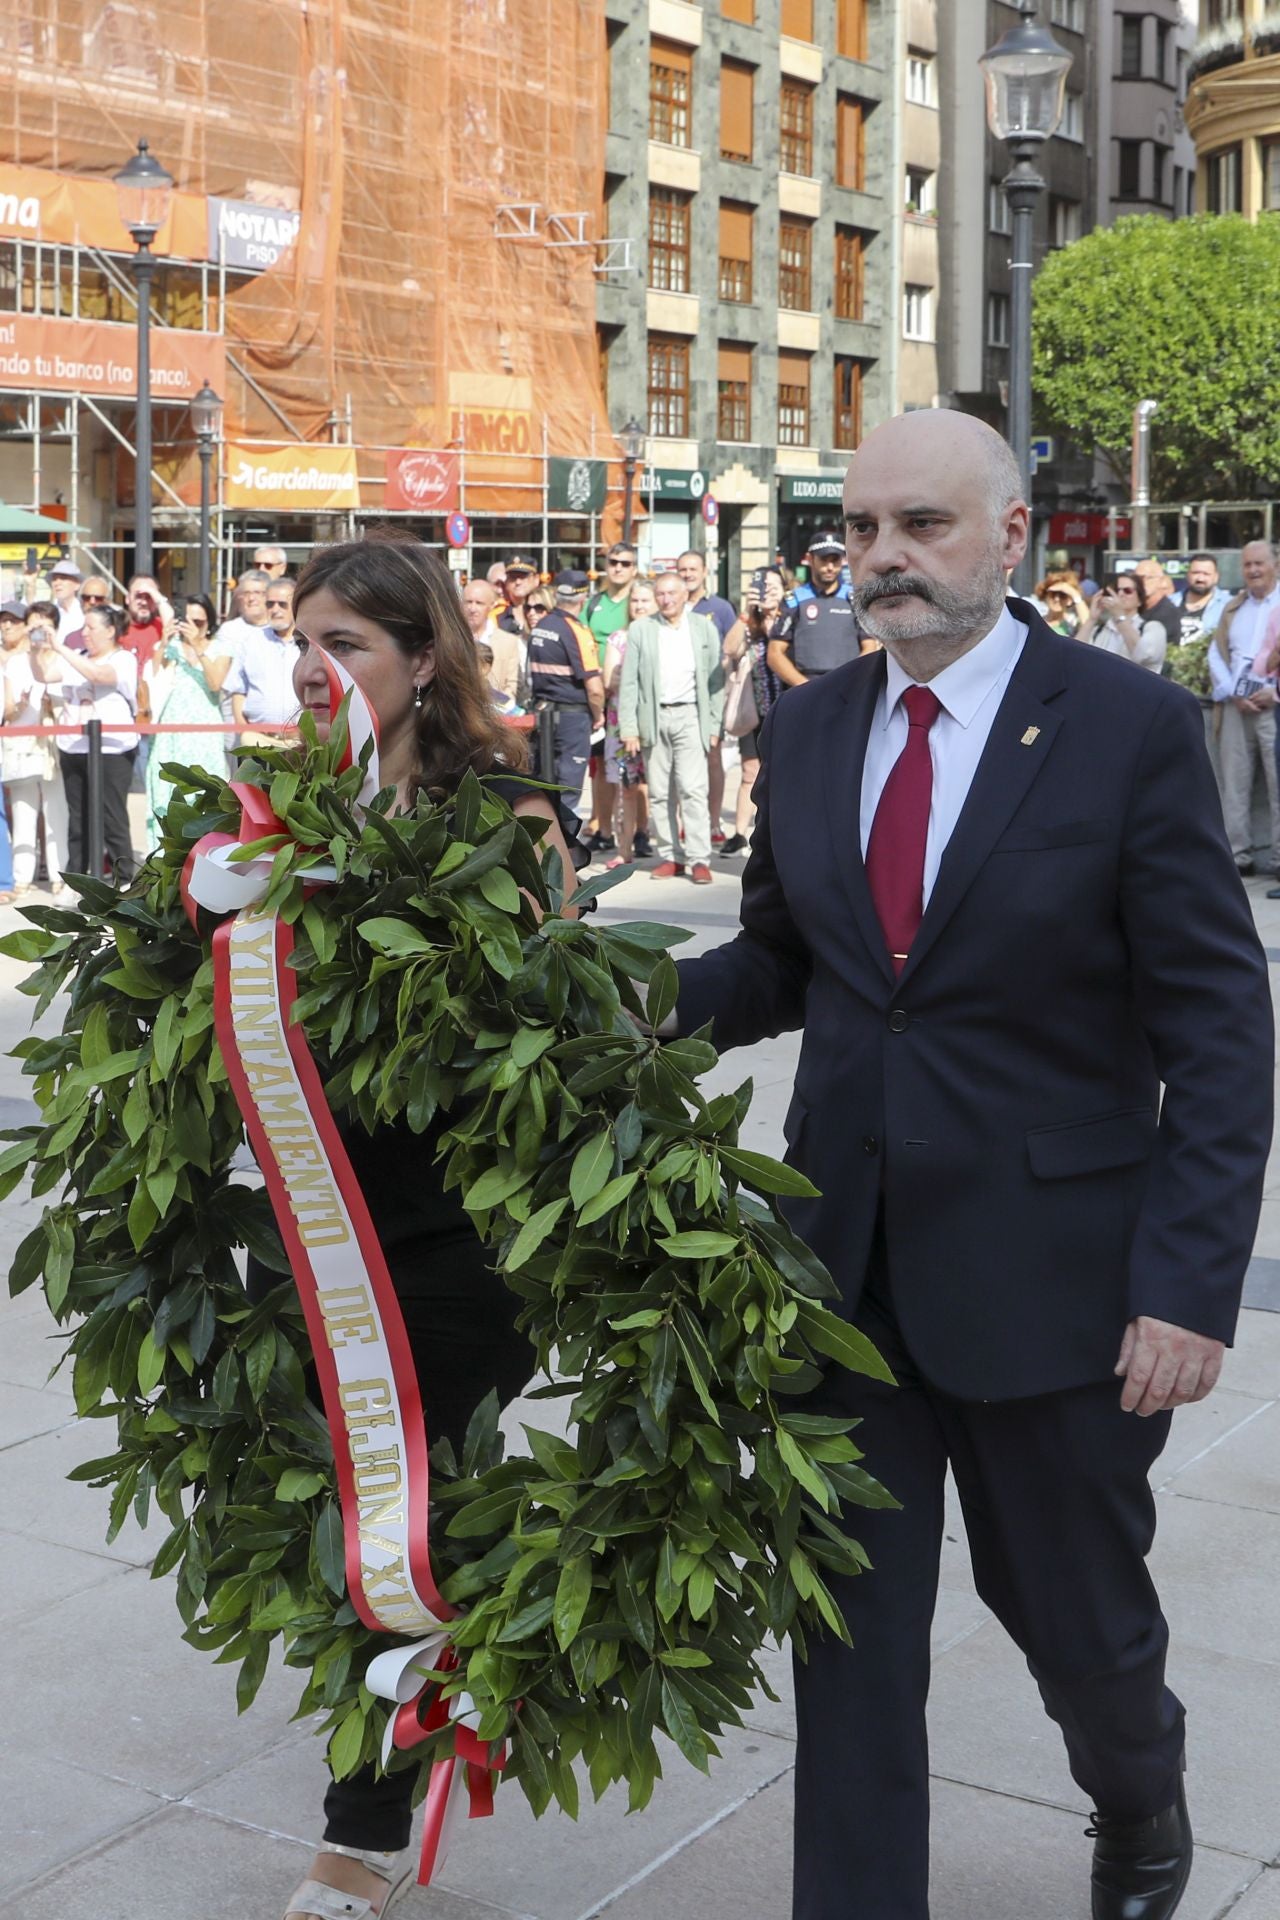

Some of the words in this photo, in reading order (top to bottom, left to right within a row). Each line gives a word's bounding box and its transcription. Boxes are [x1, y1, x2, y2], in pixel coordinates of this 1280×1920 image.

[246, 243, 278, 265] PISO
[34, 354, 52, 377] tu
[55, 355, 104, 381] banco
[107, 360, 133, 384] (no
[149, 367, 191, 389] anco).
[792, 481, 818, 498] LUDO
[229, 900, 350, 1248] AYUNTAMIENTO
[315, 1283, 380, 1350] DE
